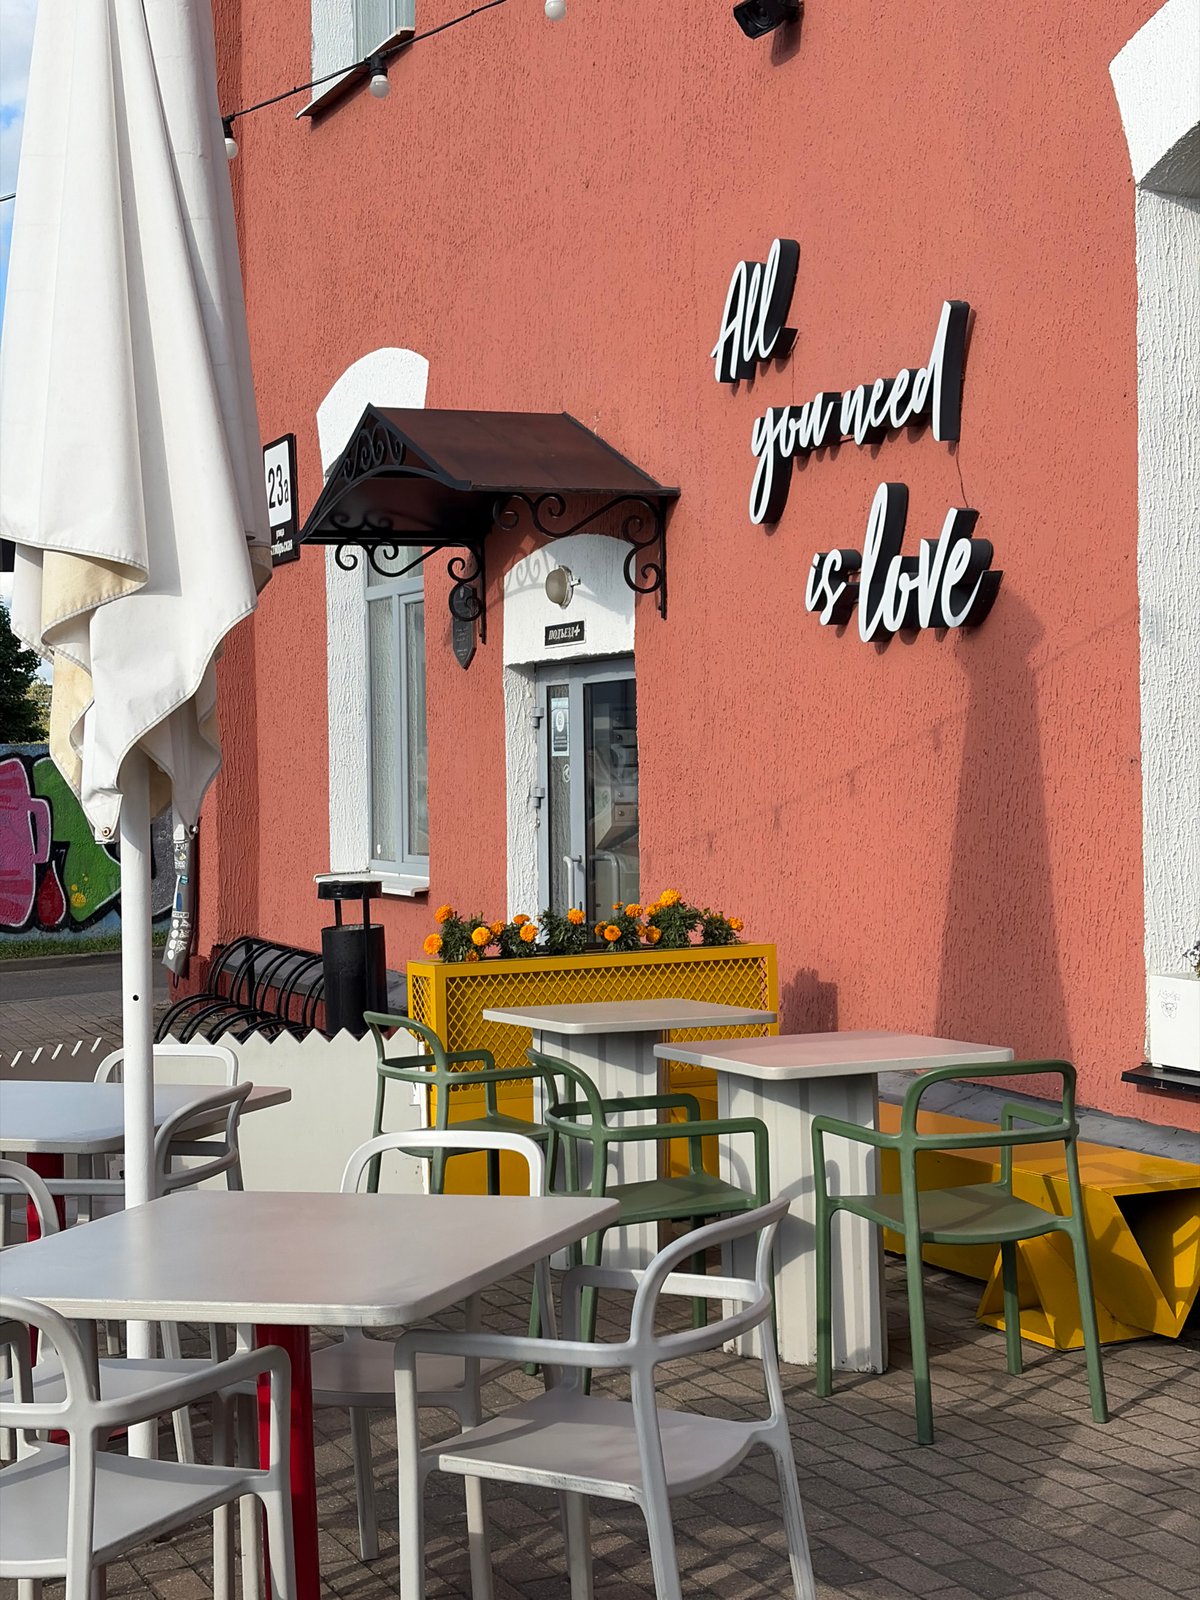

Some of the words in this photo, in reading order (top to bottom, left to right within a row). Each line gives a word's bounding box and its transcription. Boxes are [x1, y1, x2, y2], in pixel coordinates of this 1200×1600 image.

[710, 238, 783, 383] All
[749, 392, 836, 525] you
[839, 300, 952, 442] need
[268, 464, 289, 509] 23а
[548, 627, 574, 641] ПОДЪЕЗД
[804, 548, 846, 627] is
[858, 482, 987, 643] love
